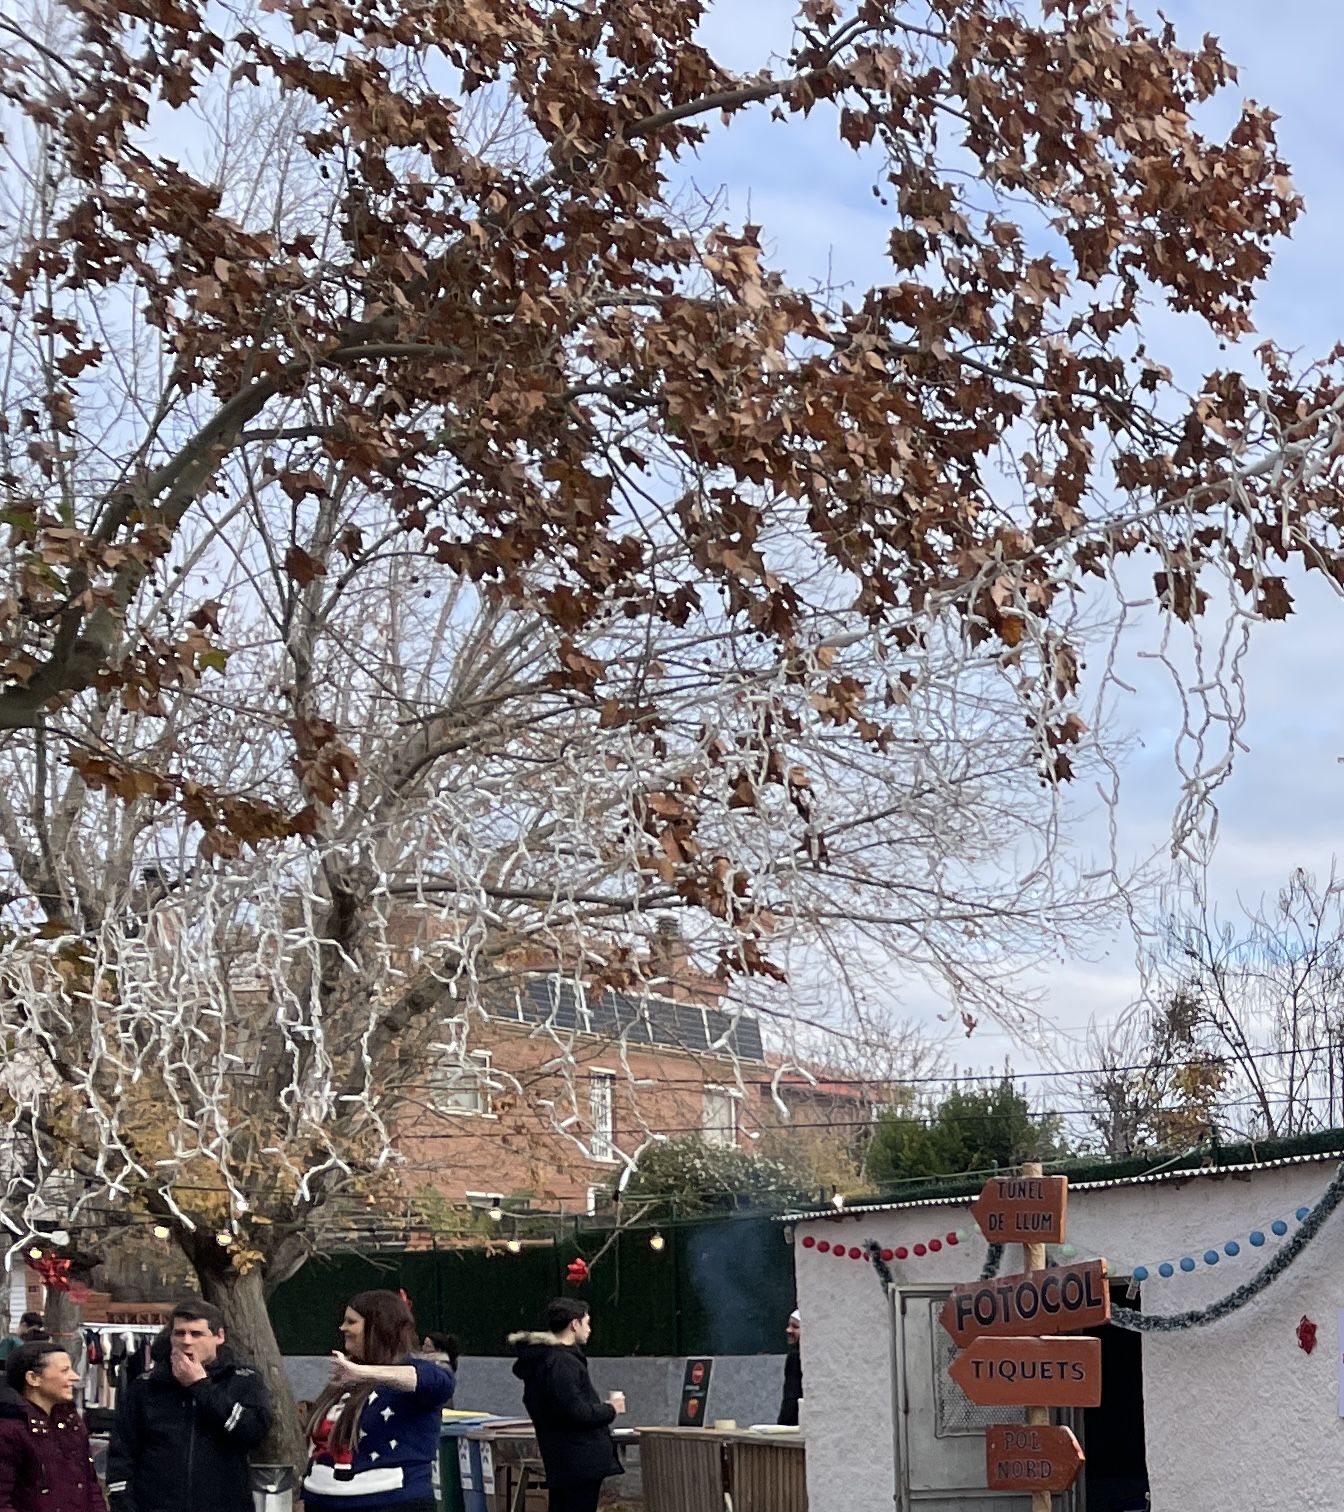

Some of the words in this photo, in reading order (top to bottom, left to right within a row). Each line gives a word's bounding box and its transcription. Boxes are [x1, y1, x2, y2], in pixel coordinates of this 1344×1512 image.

[997, 1181, 1045, 1200] TUNEL
[988, 1212, 1006, 1232] DE
[1015, 1211, 1053, 1232] LLUM
[956, 1270, 1104, 1331] FOTOCOL
[971, 1359, 1087, 1382] TIQUETS
[1004, 1431, 1041, 1451] POL
[998, 1460, 1053, 1480] NORD
